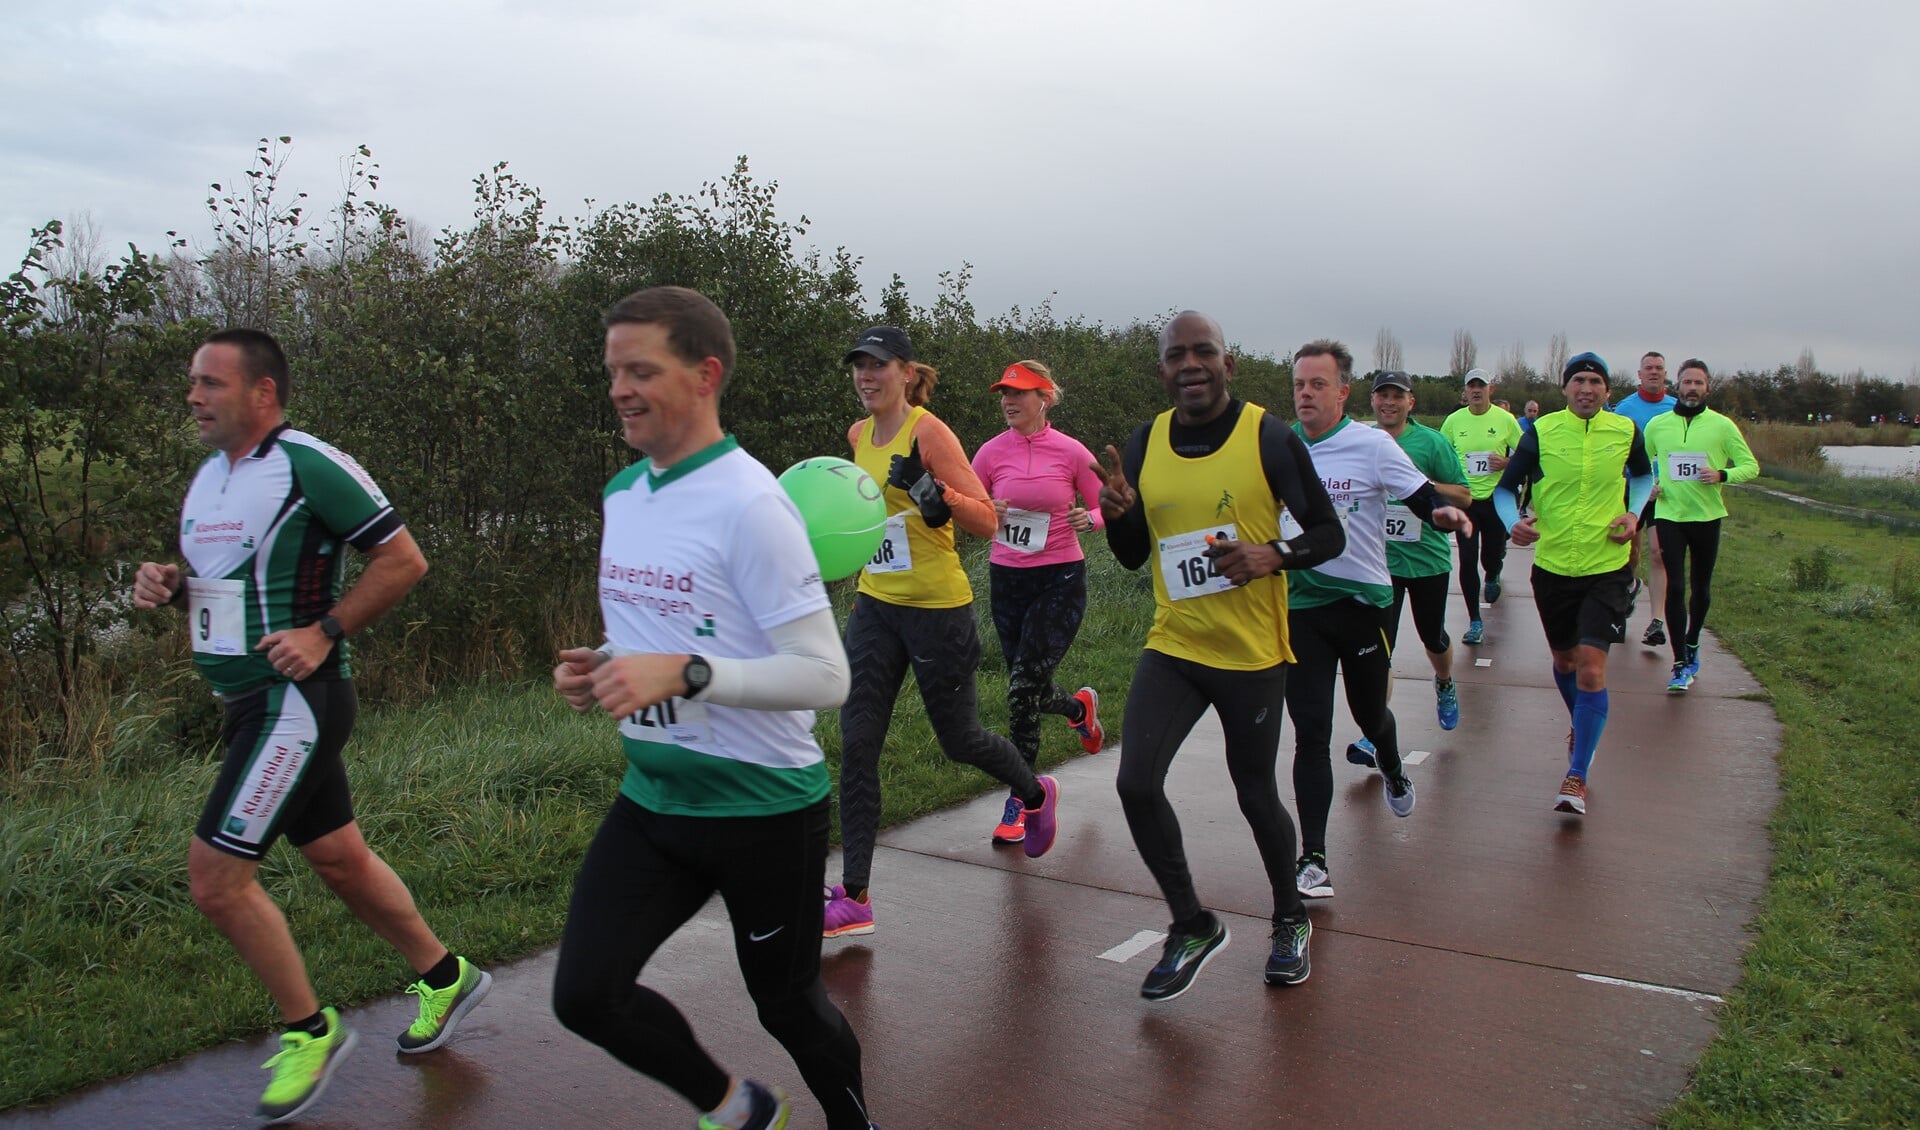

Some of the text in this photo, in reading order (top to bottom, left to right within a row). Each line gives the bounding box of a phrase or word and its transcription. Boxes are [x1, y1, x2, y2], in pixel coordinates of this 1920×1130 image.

[1475, 460, 1488, 472] 72
[1677, 463, 1697, 477] 151
[1004, 523, 1031, 546] 114
[1385, 518, 1406, 536] 52
[1177, 556, 1222, 587] 164
[199, 607, 211, 642] 9
